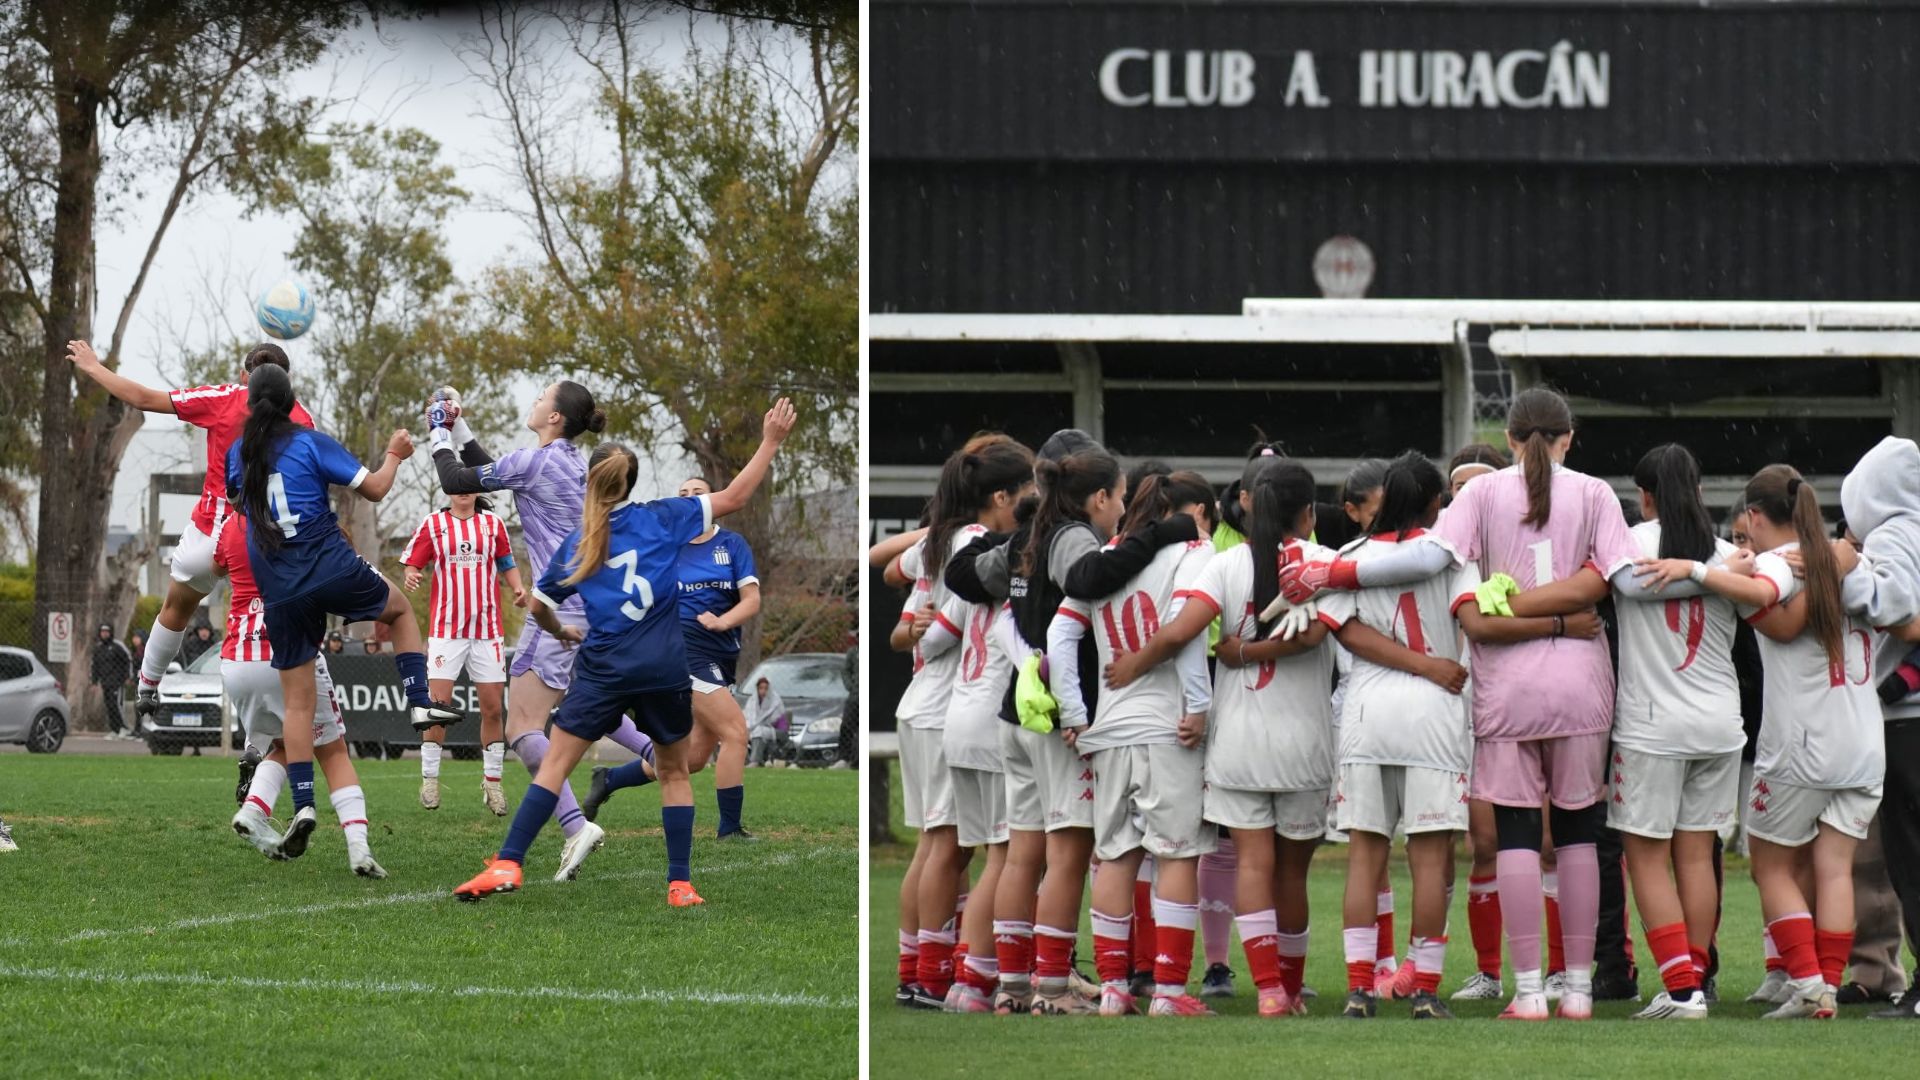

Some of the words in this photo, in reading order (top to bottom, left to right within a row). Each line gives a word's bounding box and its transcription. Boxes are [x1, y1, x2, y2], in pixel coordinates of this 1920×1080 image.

[1100, 48, 1255, 106] CLUB
[1285, 50, 1330, 107] A.
[1359, 40, 1610, 108] HURACÁN
[266, 472, 300, 539] 4
[449, 555, 482, 563] RIVADAVIA
[604, 549, 654, 622] 3
[1527, 539, 1554, 587] 1
[963, 603, 995, 683] 8
[1099, 590, 1160, 663] 10
[333, 684, 408, 711] ADAV
